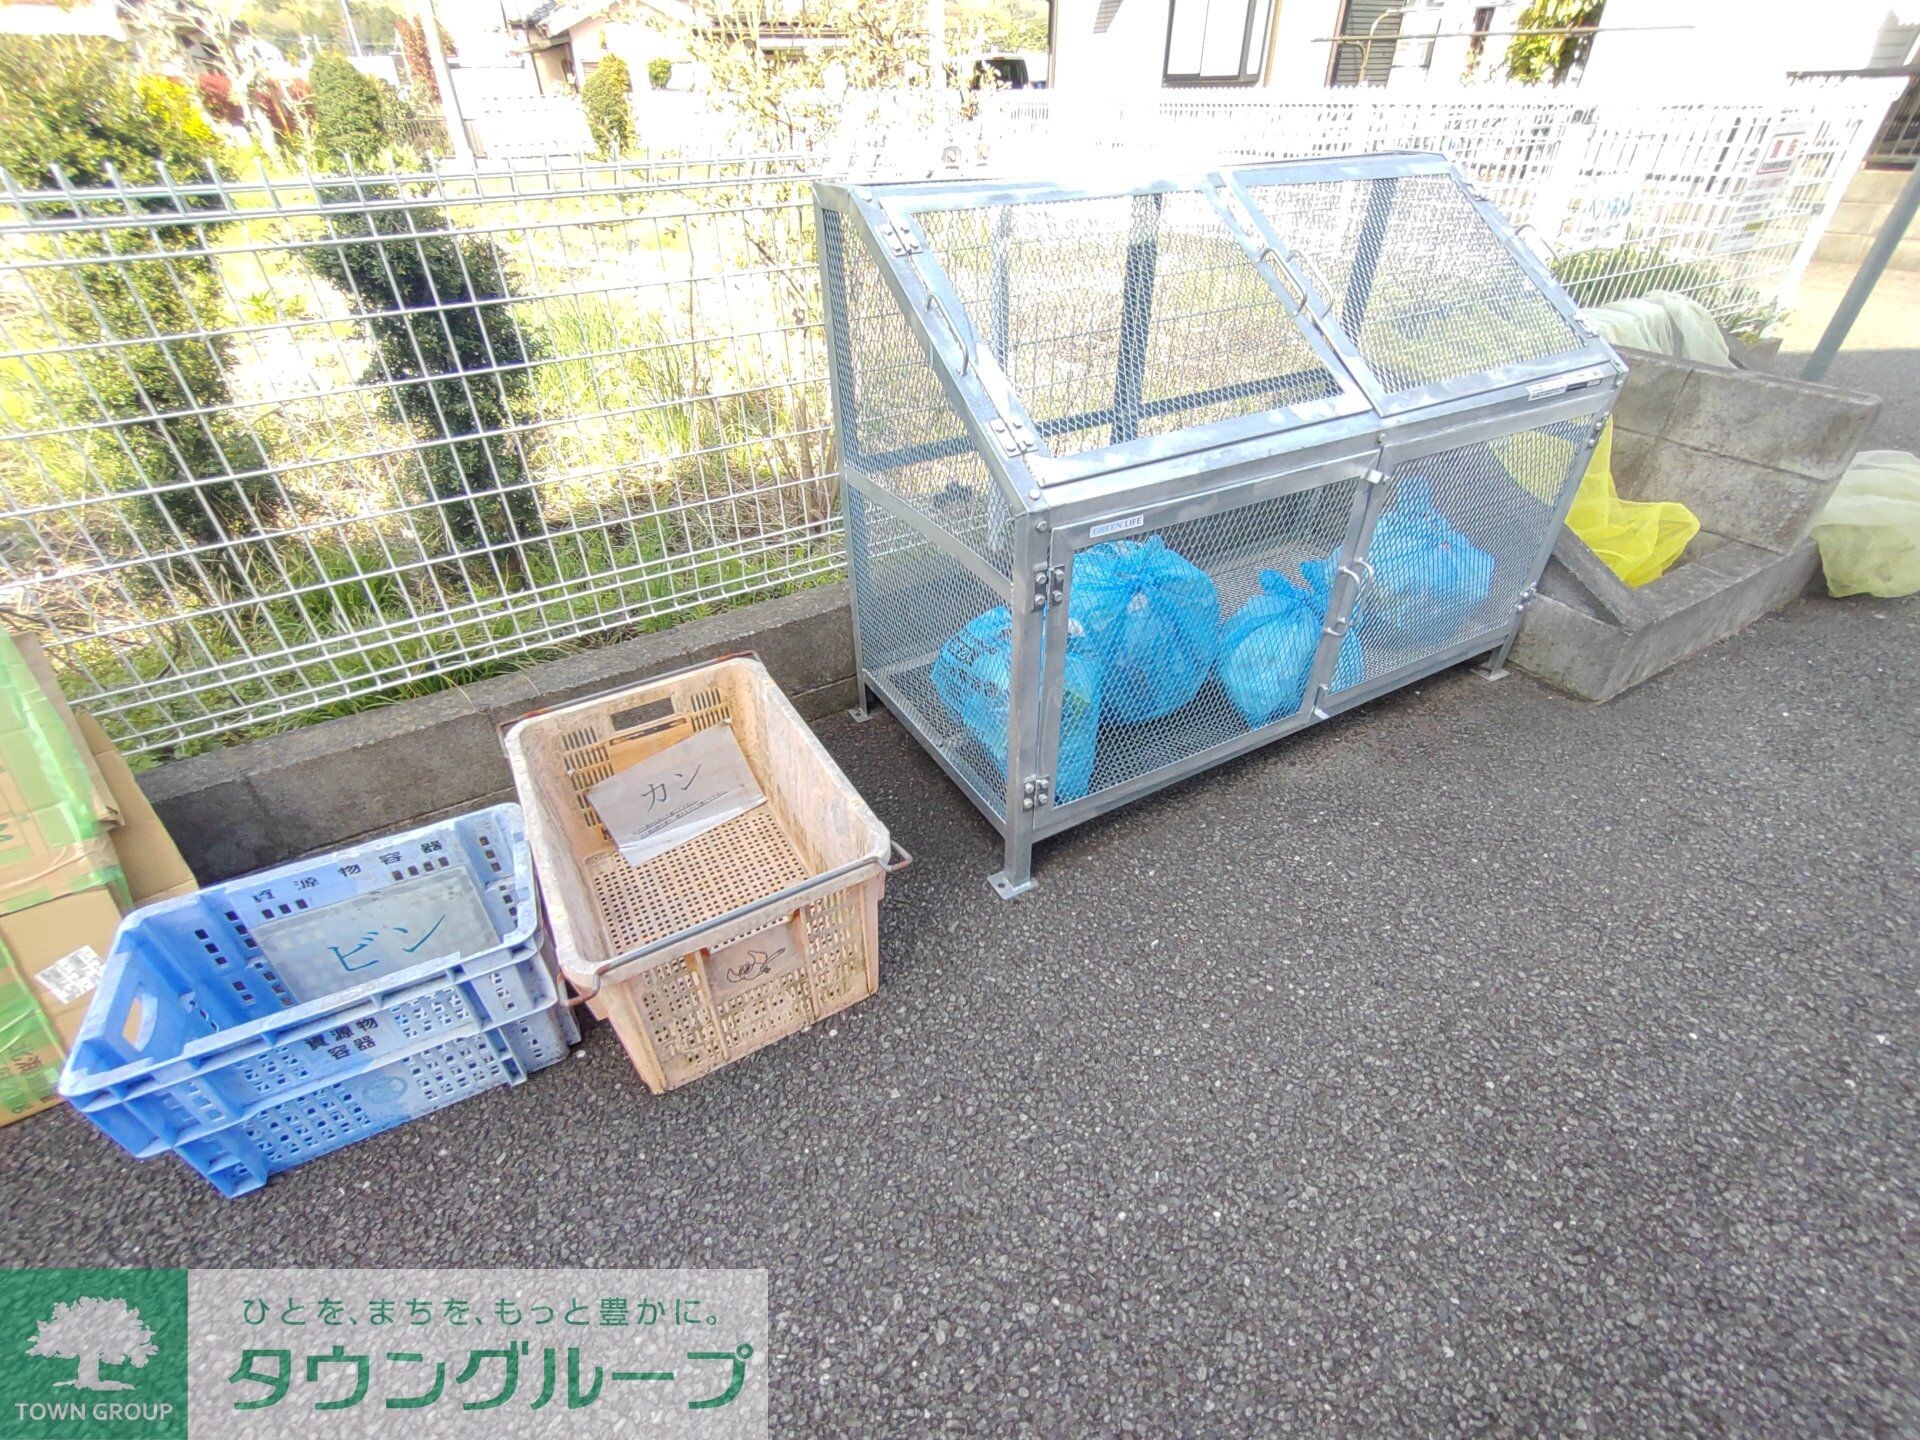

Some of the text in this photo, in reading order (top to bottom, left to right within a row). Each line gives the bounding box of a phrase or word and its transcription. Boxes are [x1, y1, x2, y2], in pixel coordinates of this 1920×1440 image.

[641, 764, 701, 812] カン
[327, 913, 447, 972] ビン
[328, 1035, 376, 1060] 容器
